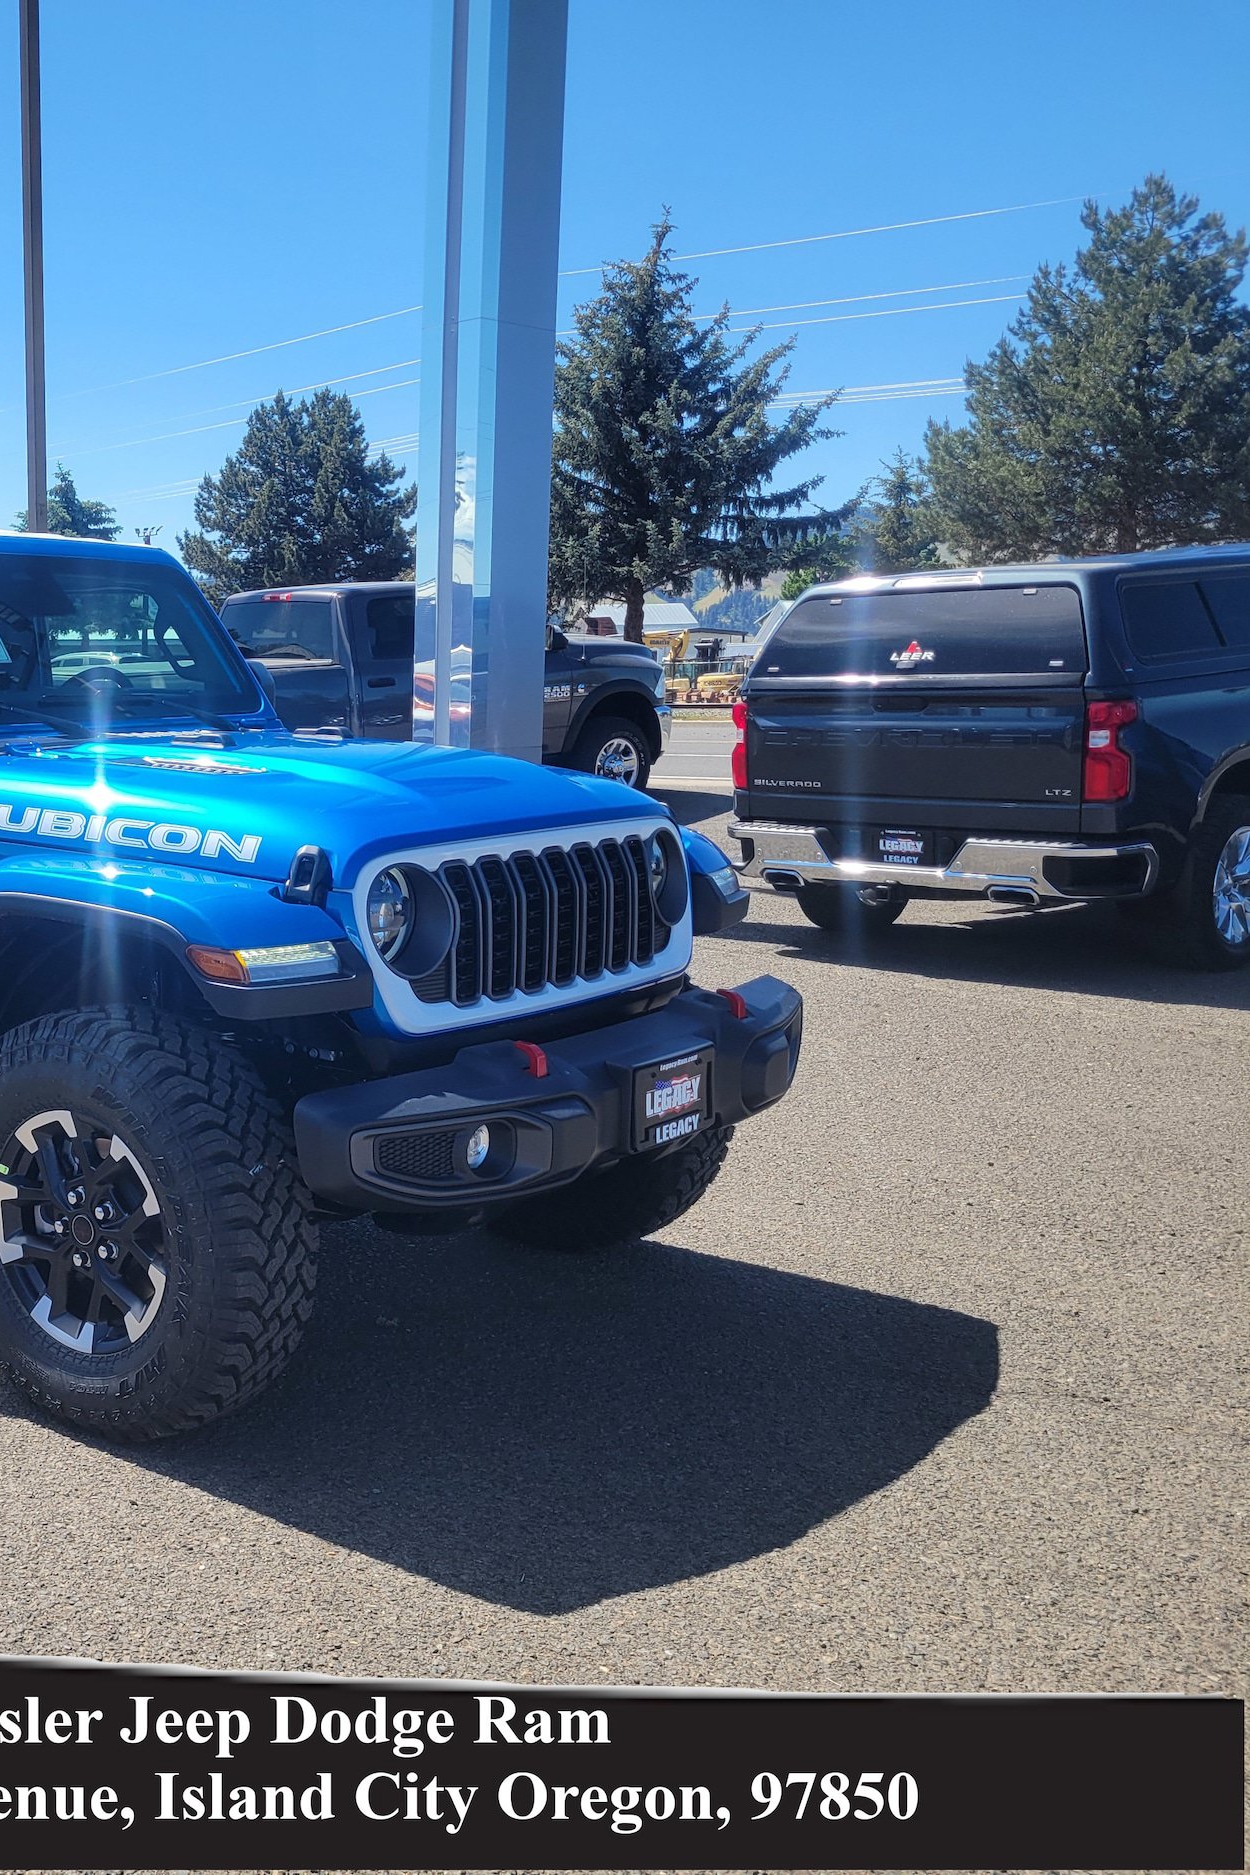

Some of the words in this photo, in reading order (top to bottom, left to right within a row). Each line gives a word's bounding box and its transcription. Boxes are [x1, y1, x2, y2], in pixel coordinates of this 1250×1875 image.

[890, 651, 935, 661] LEER
[754, 778, 822, 788] SILVERADO
[1045, 788, 1072, 797] LTZ
[879, 839, 924, 853] LEGACY
[883, 855, 919, 864] LEGACY
[645, 1076, 701, 1116] LEGACY
[655, 1113, 700, 1144] LEGACY
